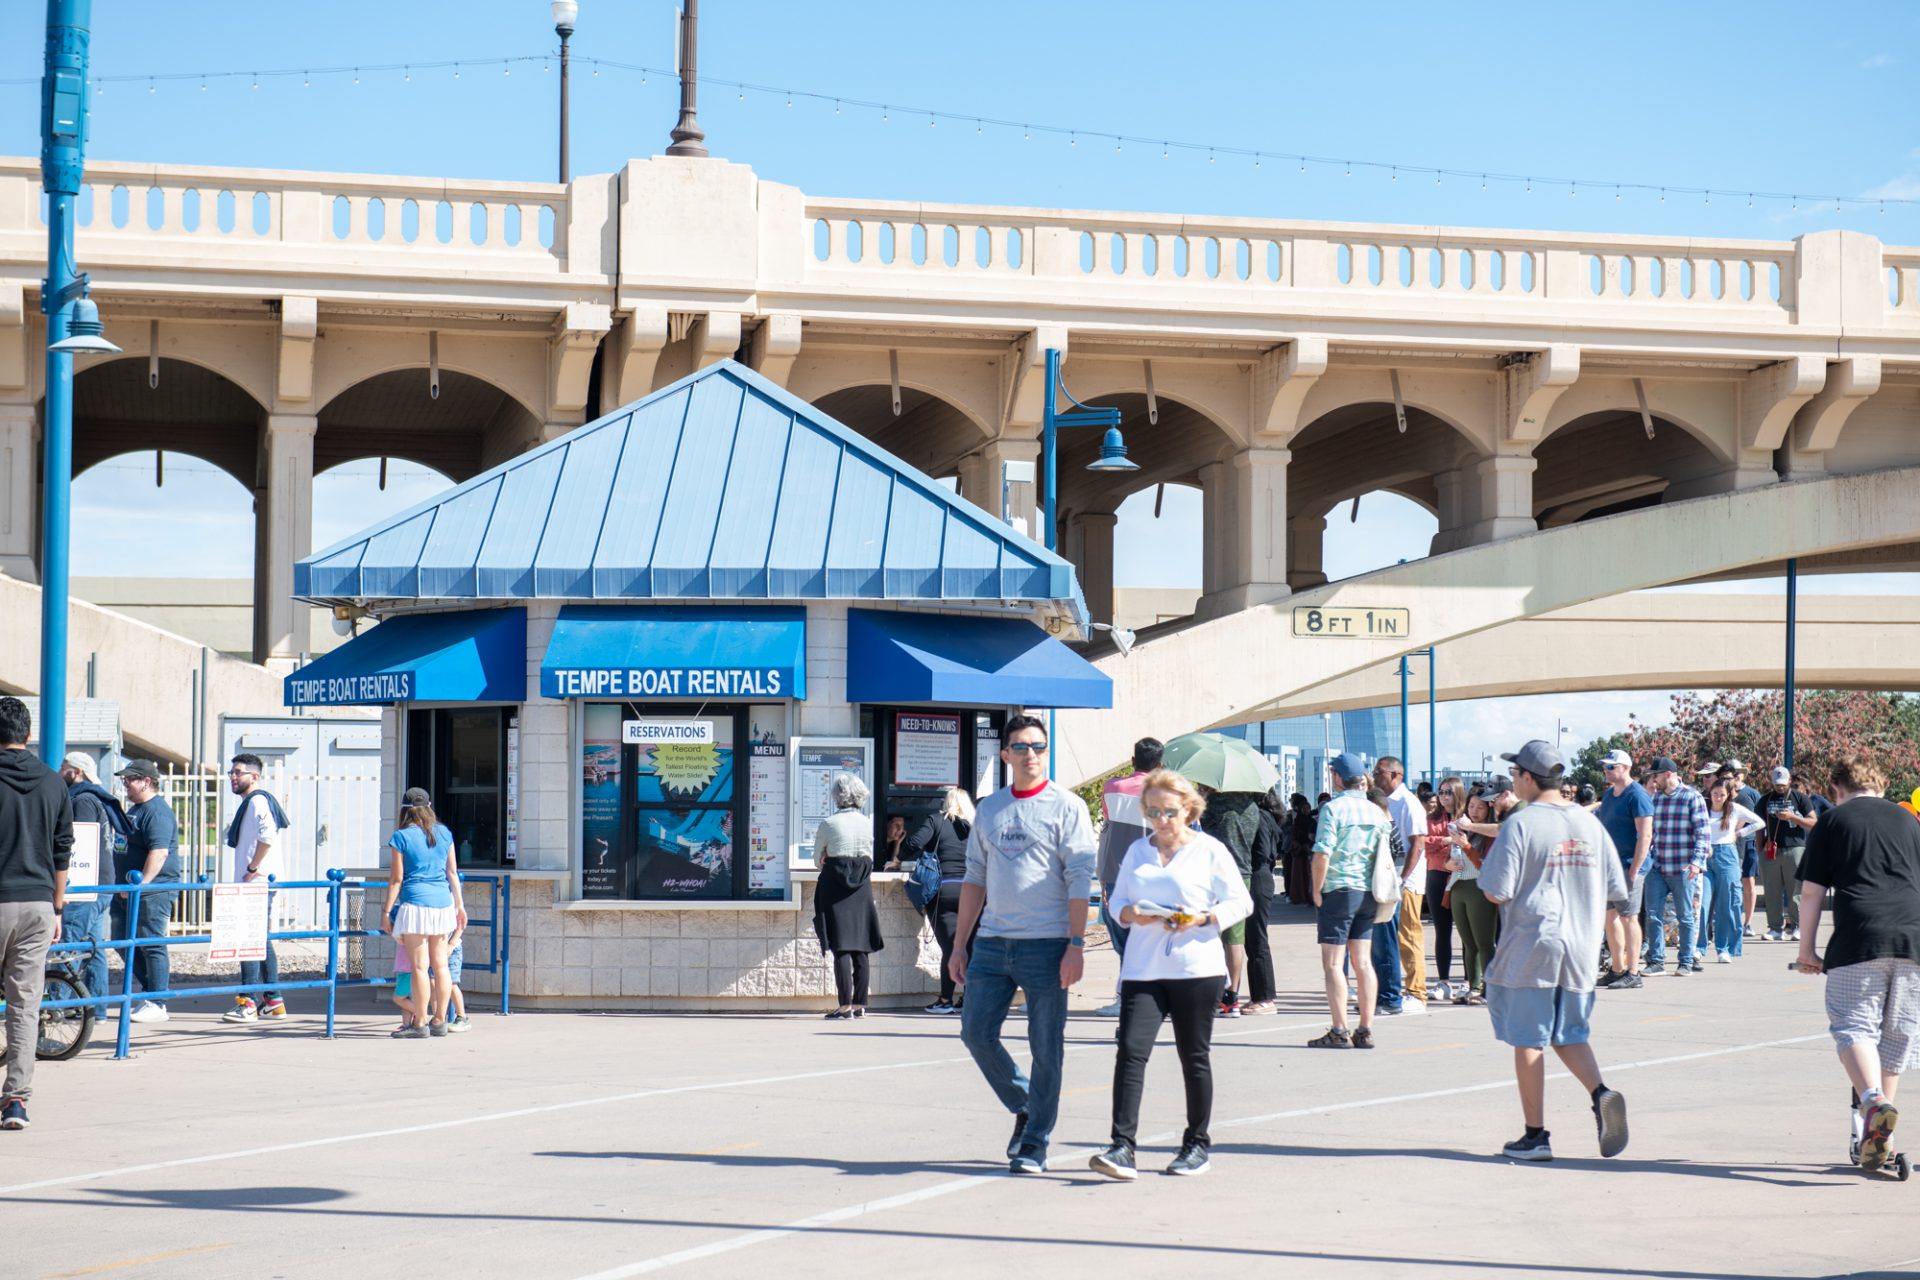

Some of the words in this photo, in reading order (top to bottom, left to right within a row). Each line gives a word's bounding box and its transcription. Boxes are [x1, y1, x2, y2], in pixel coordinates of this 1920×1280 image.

[555, 670, 623, 694] TEMPE
[628, 669, 683, 694] BOAT
[688, 669, 781, 694] RENTALS
[291, 680, 327, 703] TEMPE
[329, 677, 357, 701] BOAT
[360, 673, 409, 699] RENTALS
[509, 718, 518, 727] ME
[901, 717, 956, 732] NEED-TO-KNOWS
[630, 726, 706, 738] RESERVATIONS
[977, 729, 999, 738] MENU
[672, 745, 702, 753] Record
[754, 745, 783, 755] MENU
[801, 754, 822, 762] TEMPE
[685, 763, 708, 771] Floating
[1001, 832, 1027, 841] Hurley
